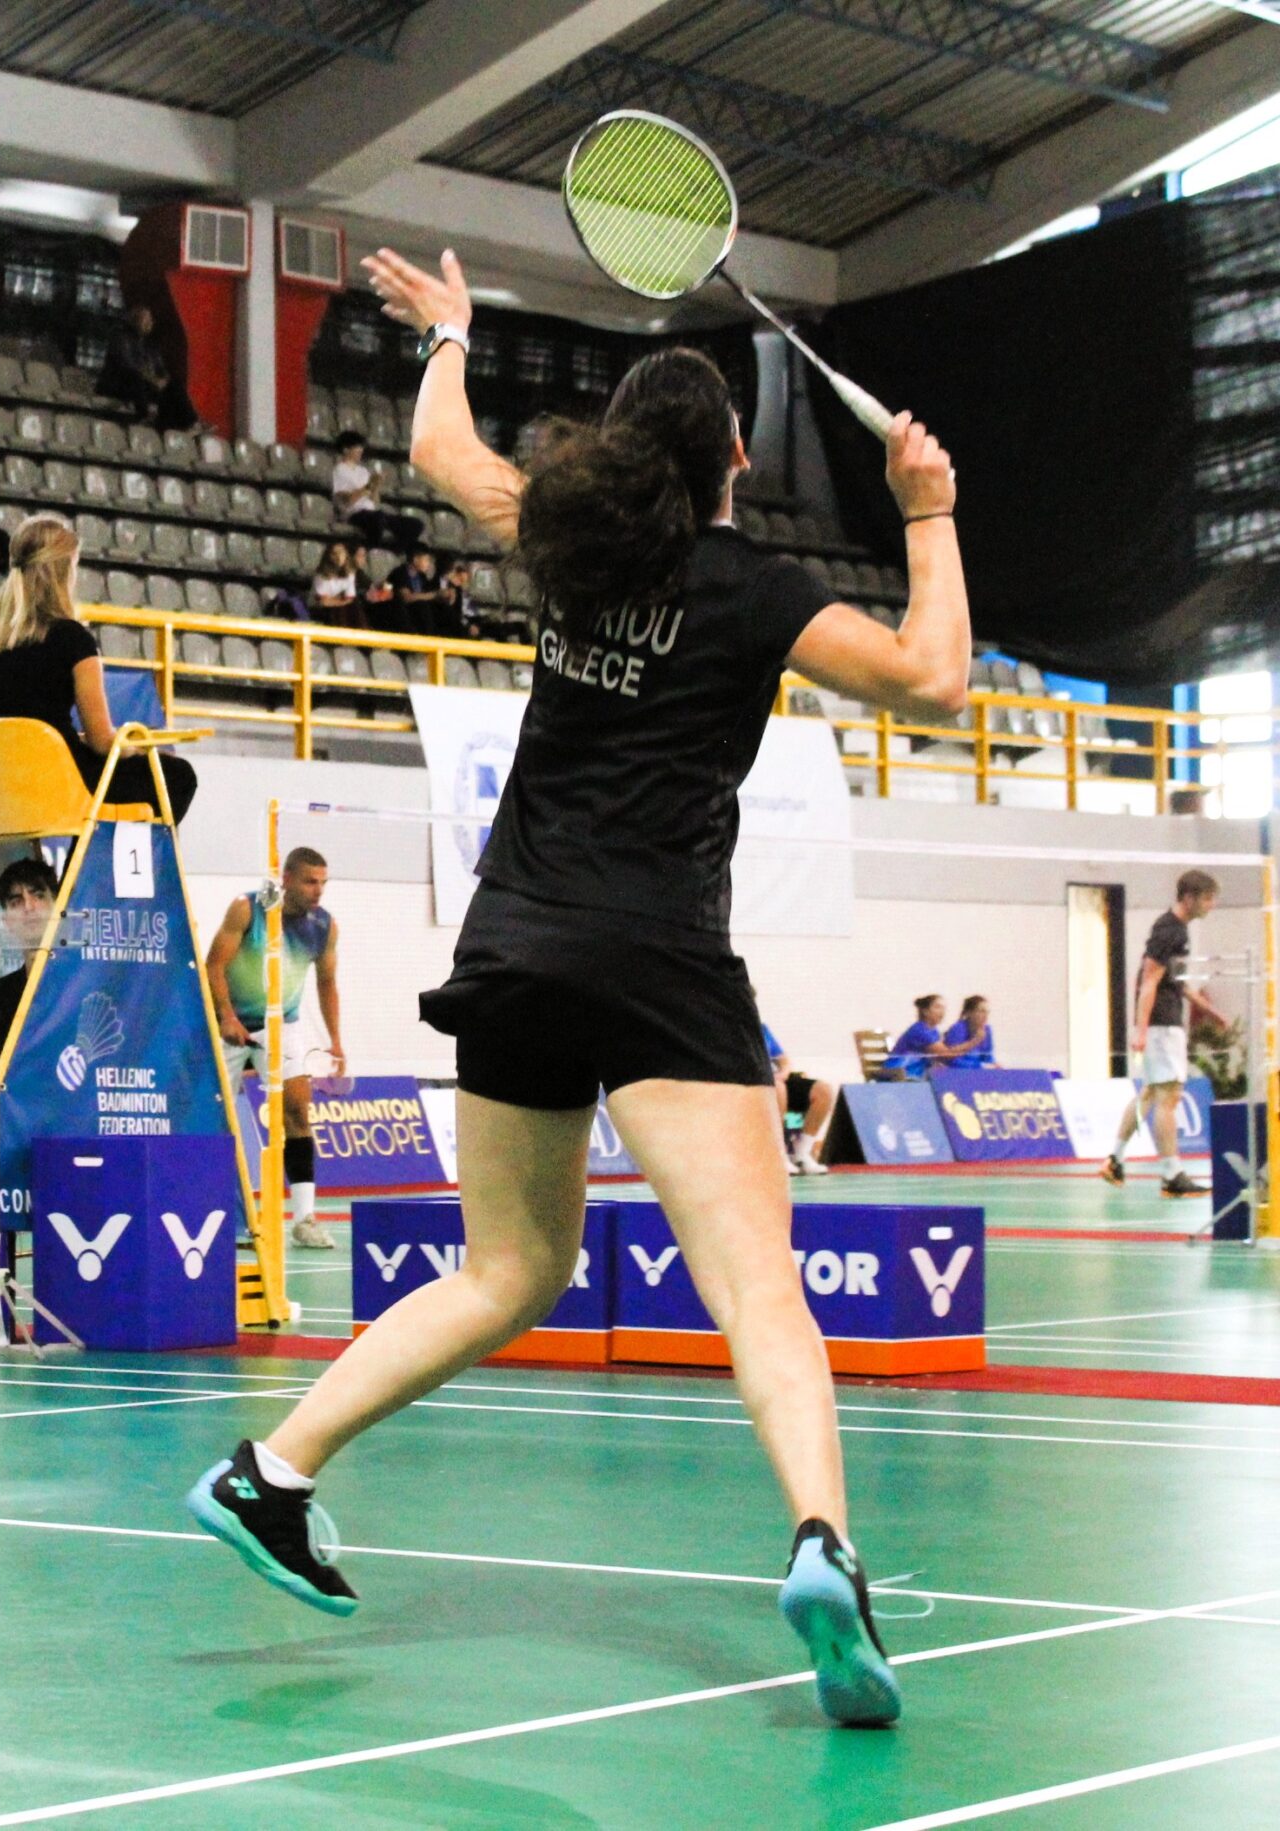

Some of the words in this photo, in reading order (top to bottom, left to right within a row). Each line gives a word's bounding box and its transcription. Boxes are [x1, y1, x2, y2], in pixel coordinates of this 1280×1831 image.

[128, 848, 141, 875] 1
[81, 908, 168, 949] HELLAS
[95, 1067, 156, 1089] HELLENIC
[97, 1092, 167, 1113] BADMINTON
[308, 1098, 422, 1123] BADMINTON
[99, 1116, 171, 1136] FEDERATION
[979, 1111, 1068, 1139] EUROPE
[311, 1122, 431, 1158] EUROPE
